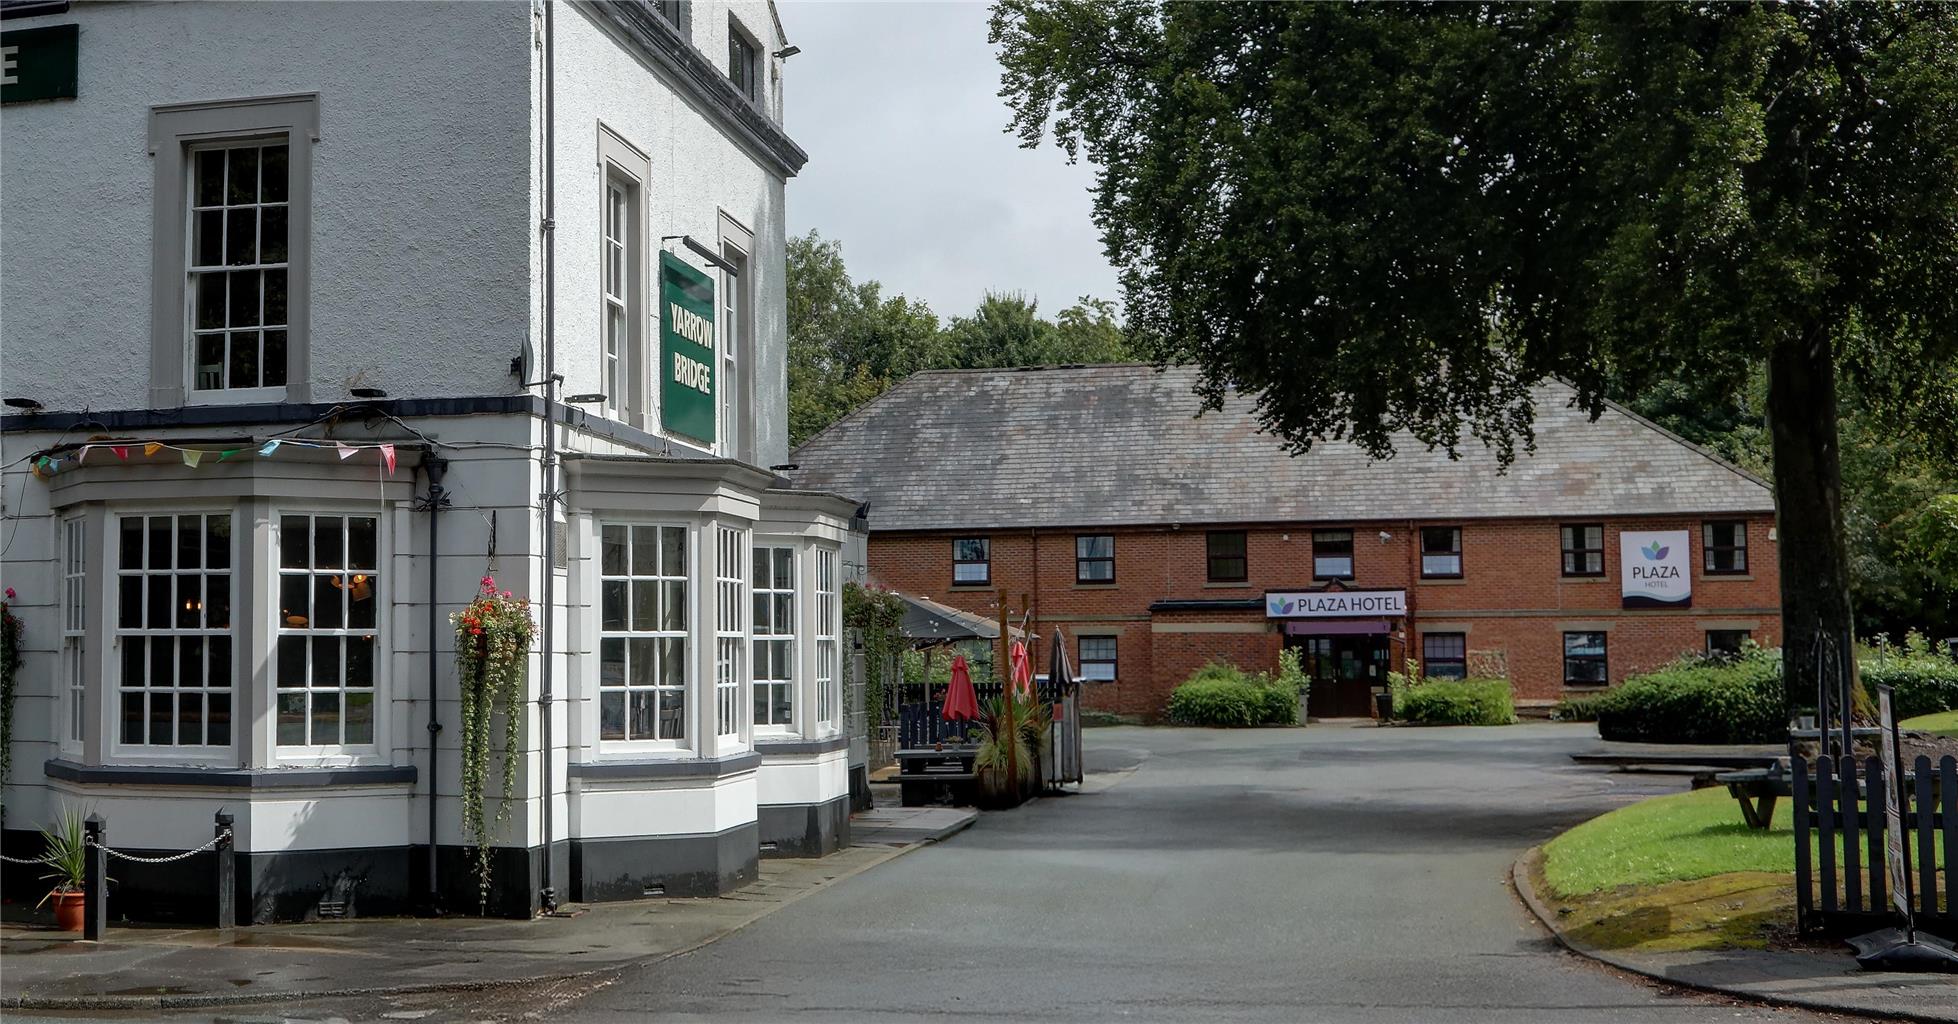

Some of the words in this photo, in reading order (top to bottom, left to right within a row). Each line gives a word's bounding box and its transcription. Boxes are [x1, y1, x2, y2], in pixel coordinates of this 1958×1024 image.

[671, 302, 713, 349] YARROW
[674, 352, 710, 394] BRIDGE
[1633, 566, 1680, 579] PLAZA
[1298, 598, 1347, 612] PLAZA
[1351, 597, 1401, 611] HOTEL
